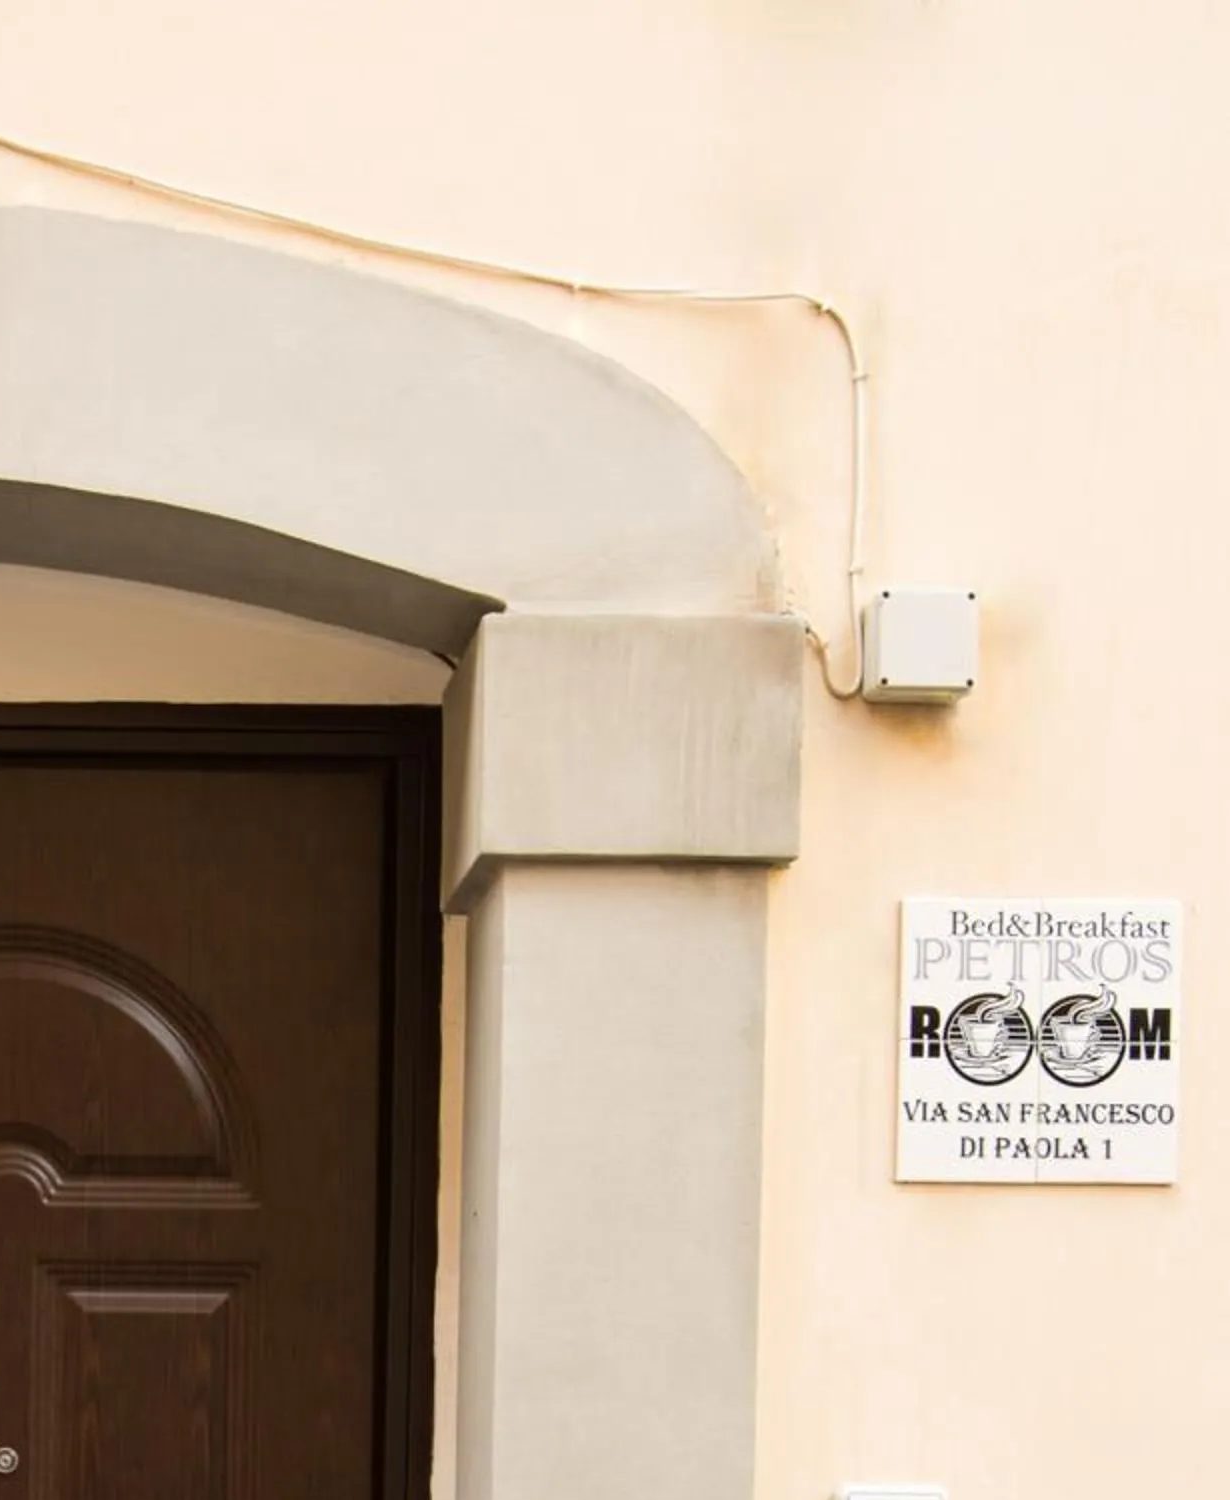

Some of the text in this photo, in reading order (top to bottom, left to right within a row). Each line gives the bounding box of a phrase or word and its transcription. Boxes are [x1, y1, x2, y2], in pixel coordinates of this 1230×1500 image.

[950, 910, 1171, 938] Bed&Breakfast
[913, 938, 1173, 983] PETROS
[909, 992, 1172, 1088] ROOM
[903, 1099, 1175, 1125] VIA SAN FRANCESCO
[960, 1136, 1113, 1160] DI PAOLA 1
